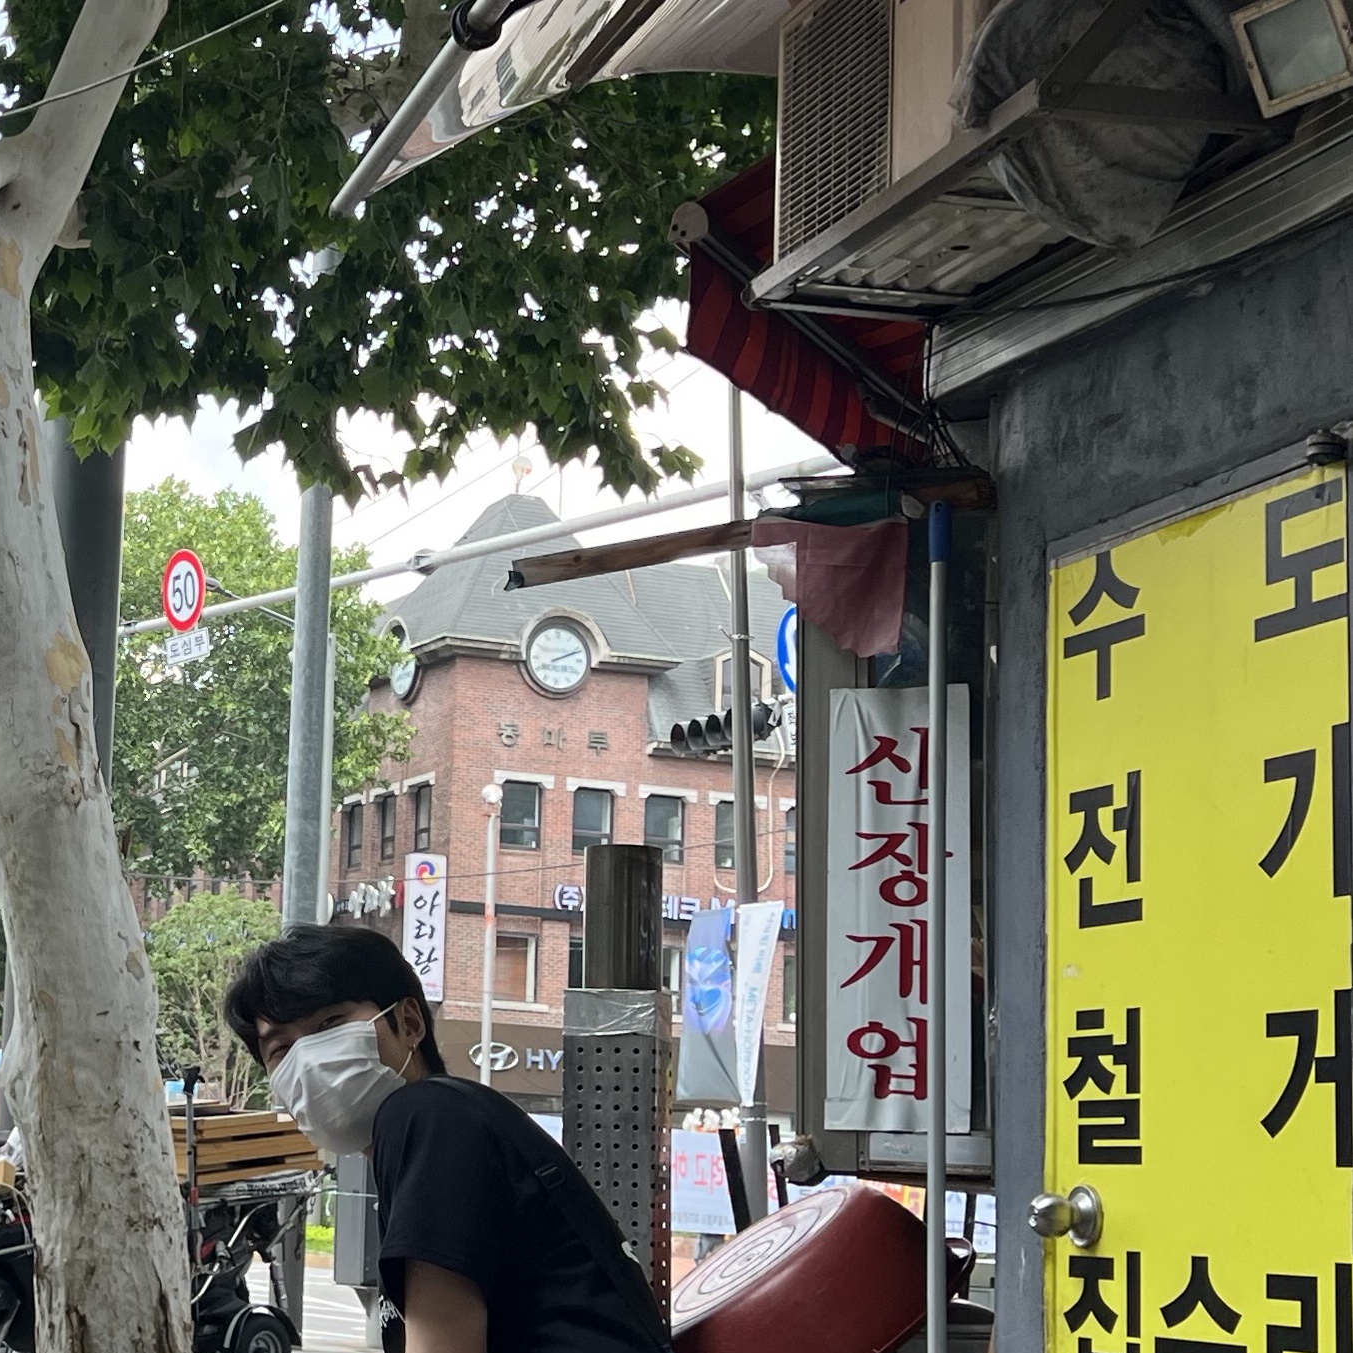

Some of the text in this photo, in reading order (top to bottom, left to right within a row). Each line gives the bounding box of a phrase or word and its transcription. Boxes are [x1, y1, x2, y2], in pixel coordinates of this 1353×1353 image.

[172, 571, 196, 613] 50
[170, 634, 205, 658] 도심부
[412, 889, 441, 976] 아리랑
[840, 727, 953, 1100] 신장개업
